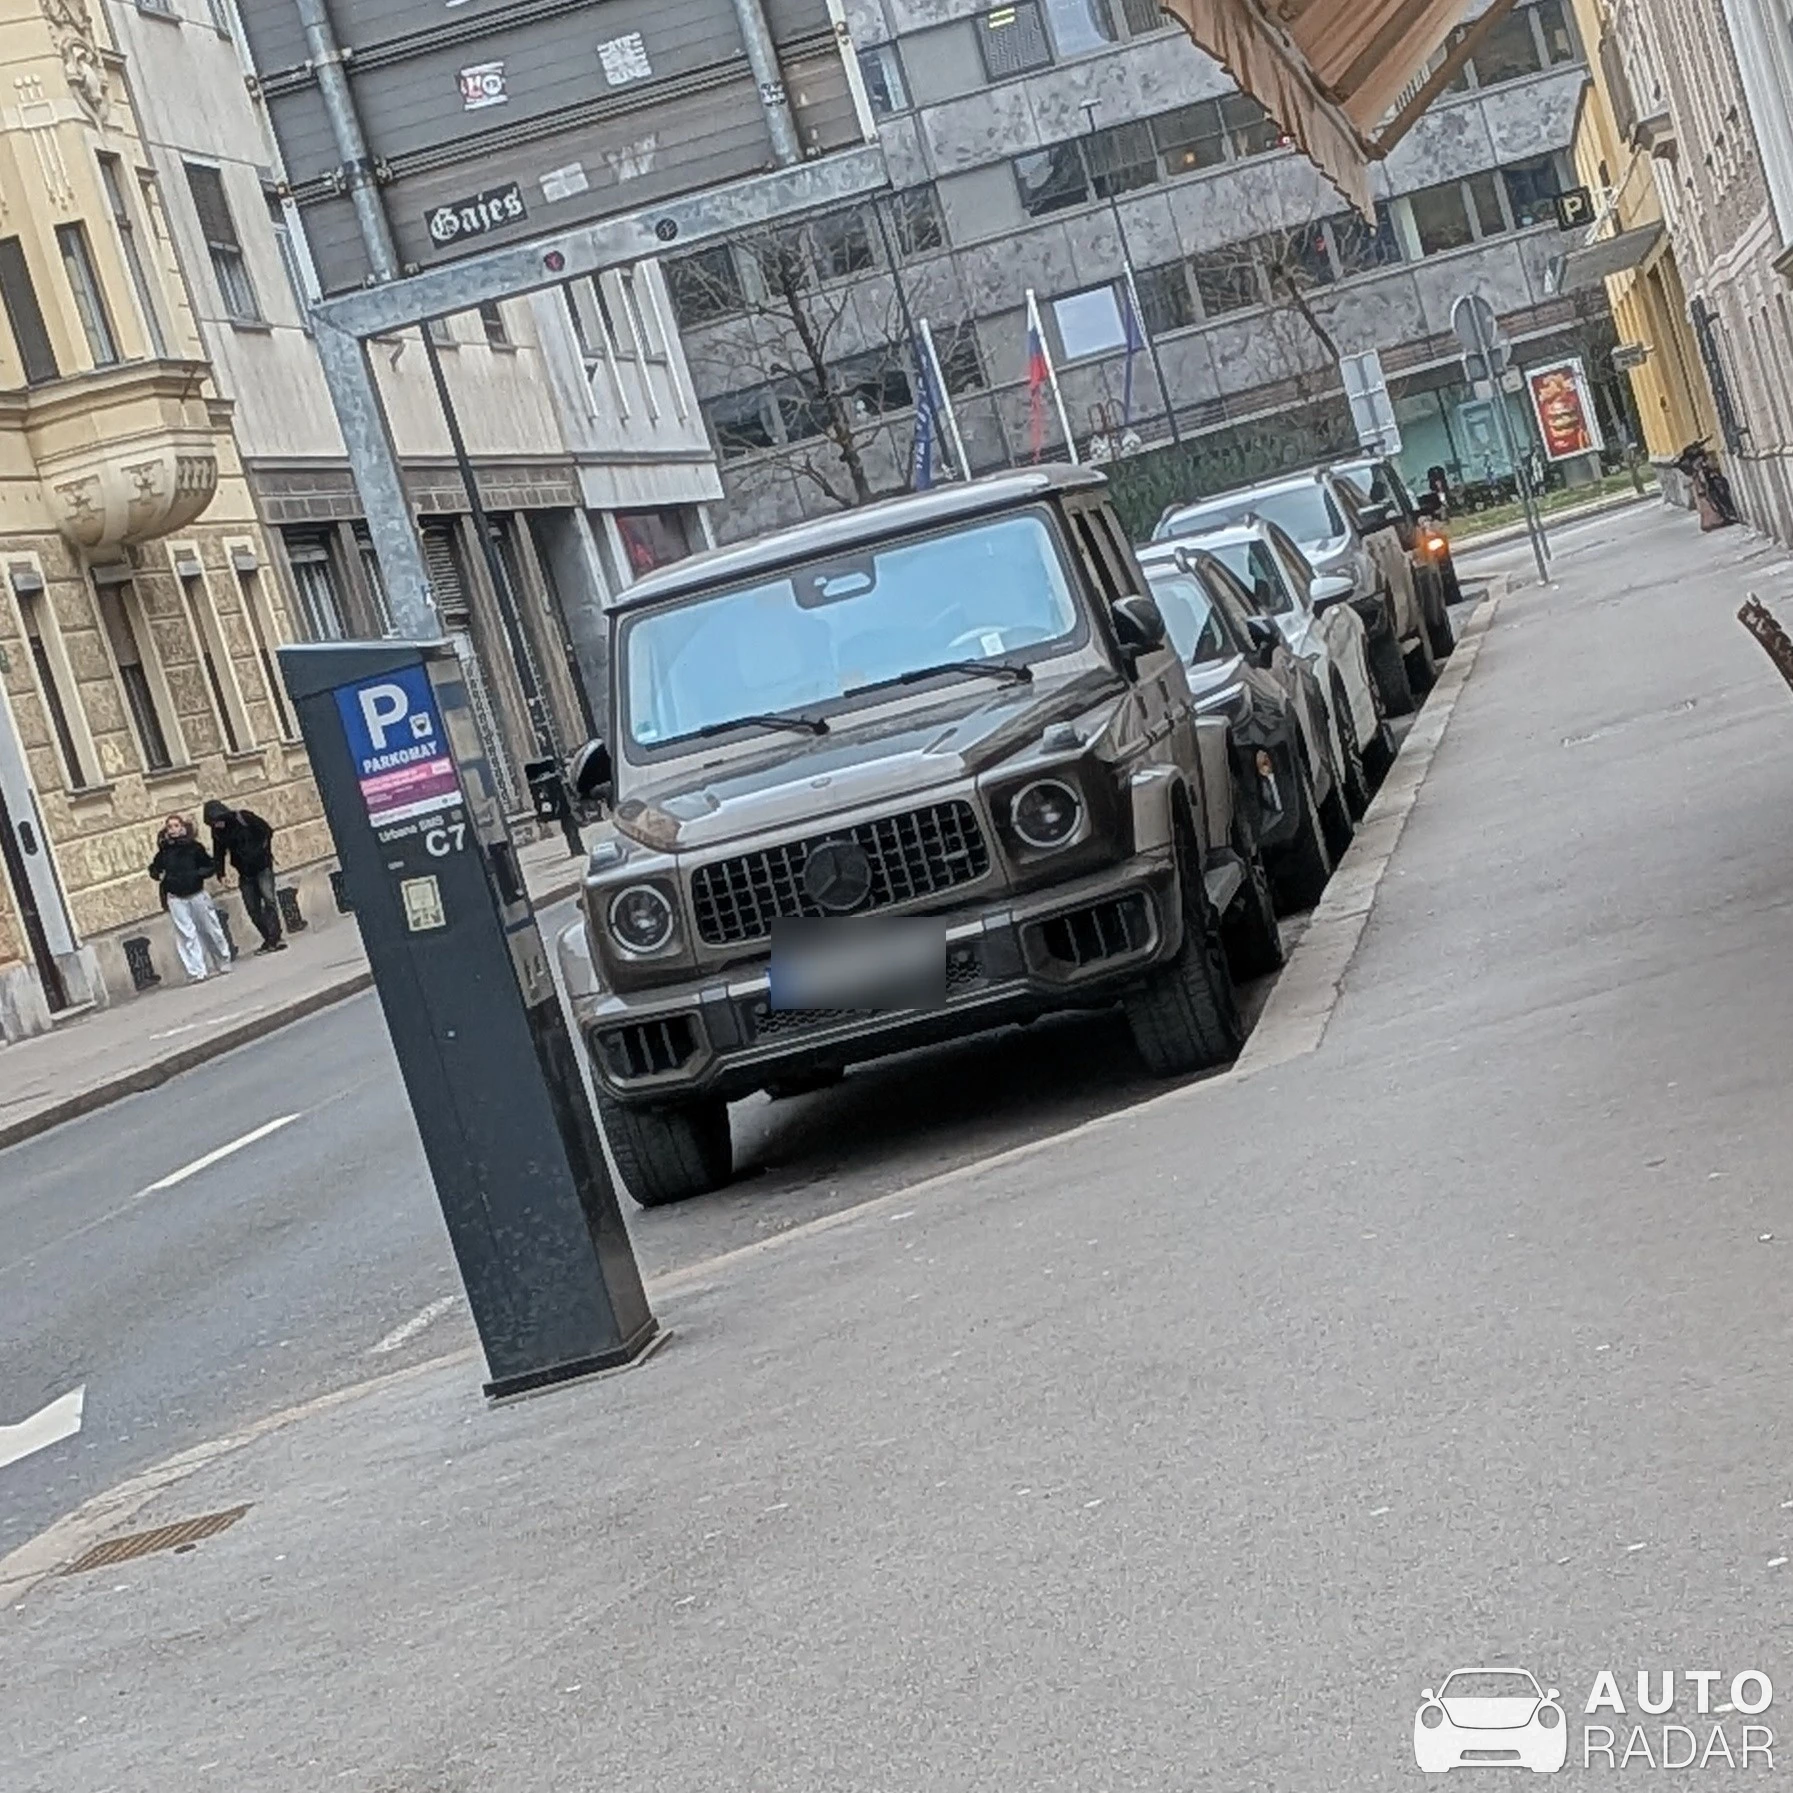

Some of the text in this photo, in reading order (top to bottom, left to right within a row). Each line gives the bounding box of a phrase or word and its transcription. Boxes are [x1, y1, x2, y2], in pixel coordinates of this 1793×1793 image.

[1562, 196, 1582, 223] P
[358, 683, 408, 750] P
[425, 822, 466, 857] C7
